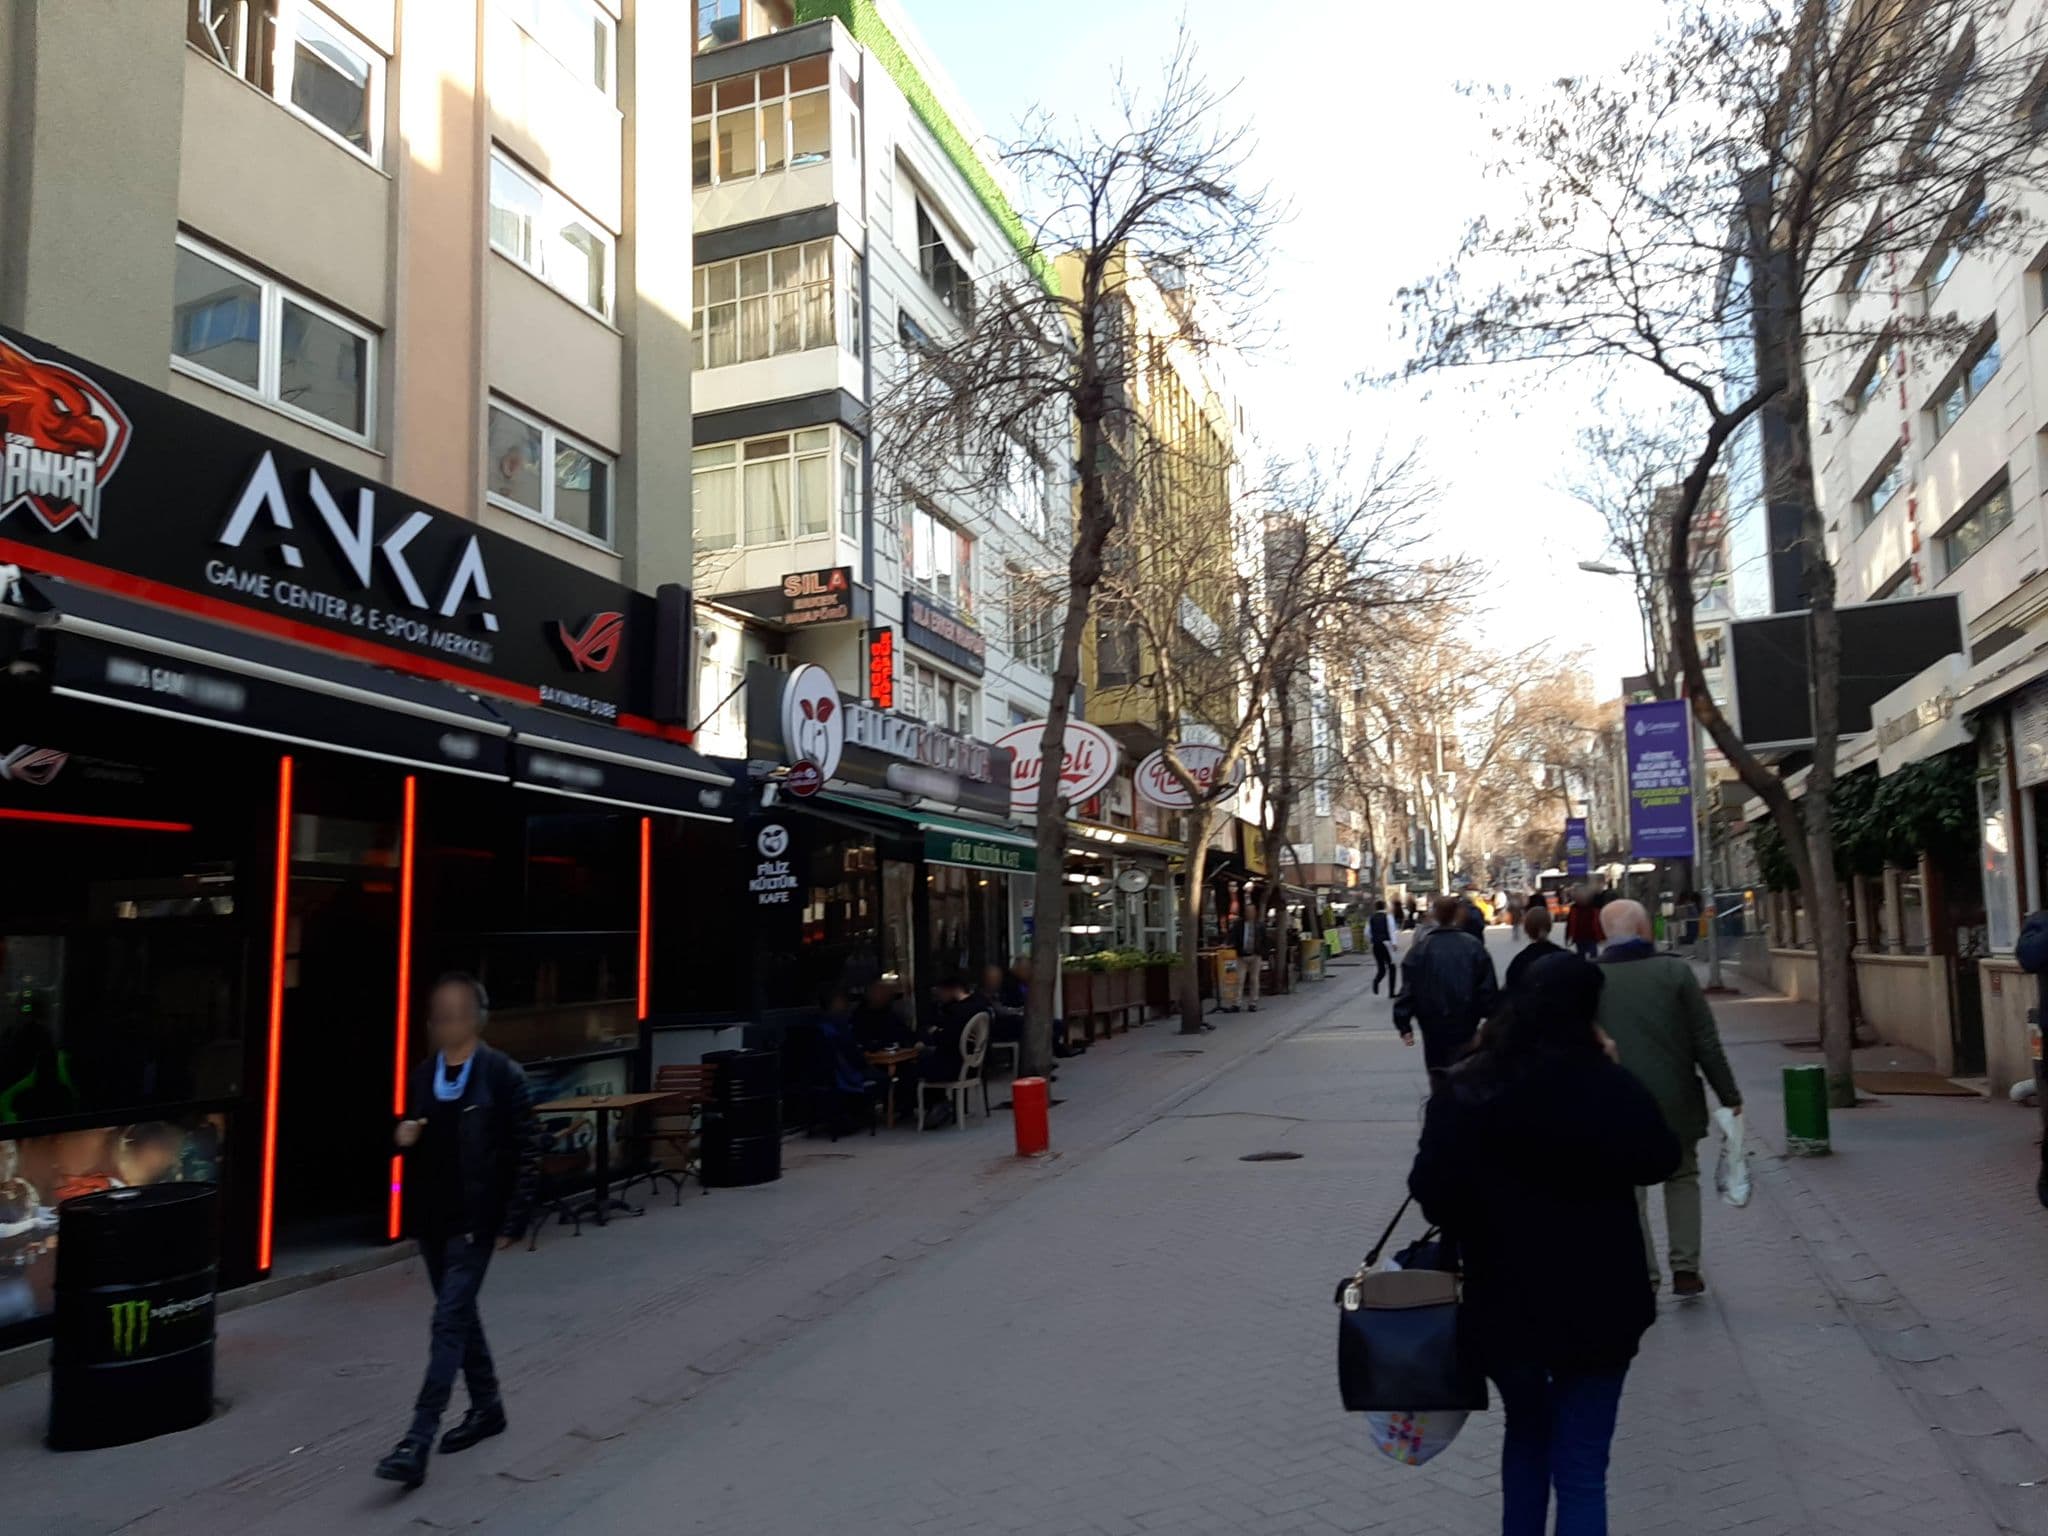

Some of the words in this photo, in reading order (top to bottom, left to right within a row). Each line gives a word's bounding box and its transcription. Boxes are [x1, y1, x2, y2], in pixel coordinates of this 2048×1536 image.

[219, 449, 499, 632] ANKA
[205, 559, 271, 599] GAME
[273, 580, 347, 621] CENTER
[350, 604, 365, 626] &
[368, 608, 429, 645] E-SPOR
[1003, 740, 1094, 784] ueli
[758, 891, 790, 904] KAFE
